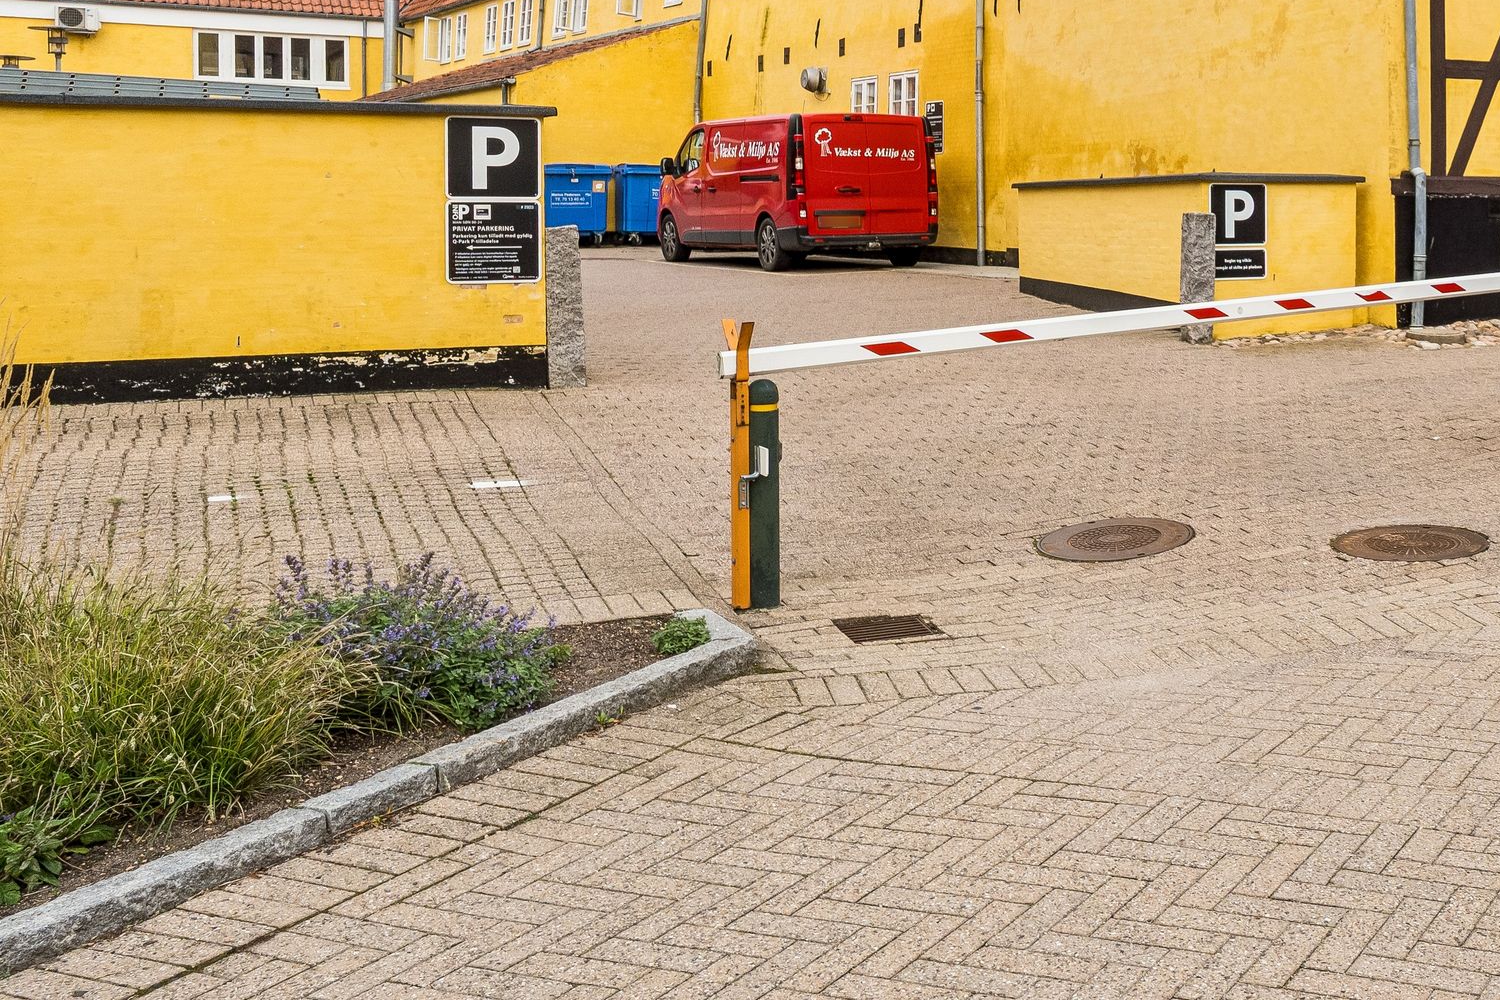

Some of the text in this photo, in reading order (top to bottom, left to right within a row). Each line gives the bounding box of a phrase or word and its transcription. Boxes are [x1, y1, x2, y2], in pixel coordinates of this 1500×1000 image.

[471, 125, 520, 190] P
[719, 141, 780, 160] Vækst & Miljø A/S
[834, 147, 915, 159] Vækst & Miljø A/S
[458, 204, 470, 220] P
[1224, 189, 1255, 238] P
